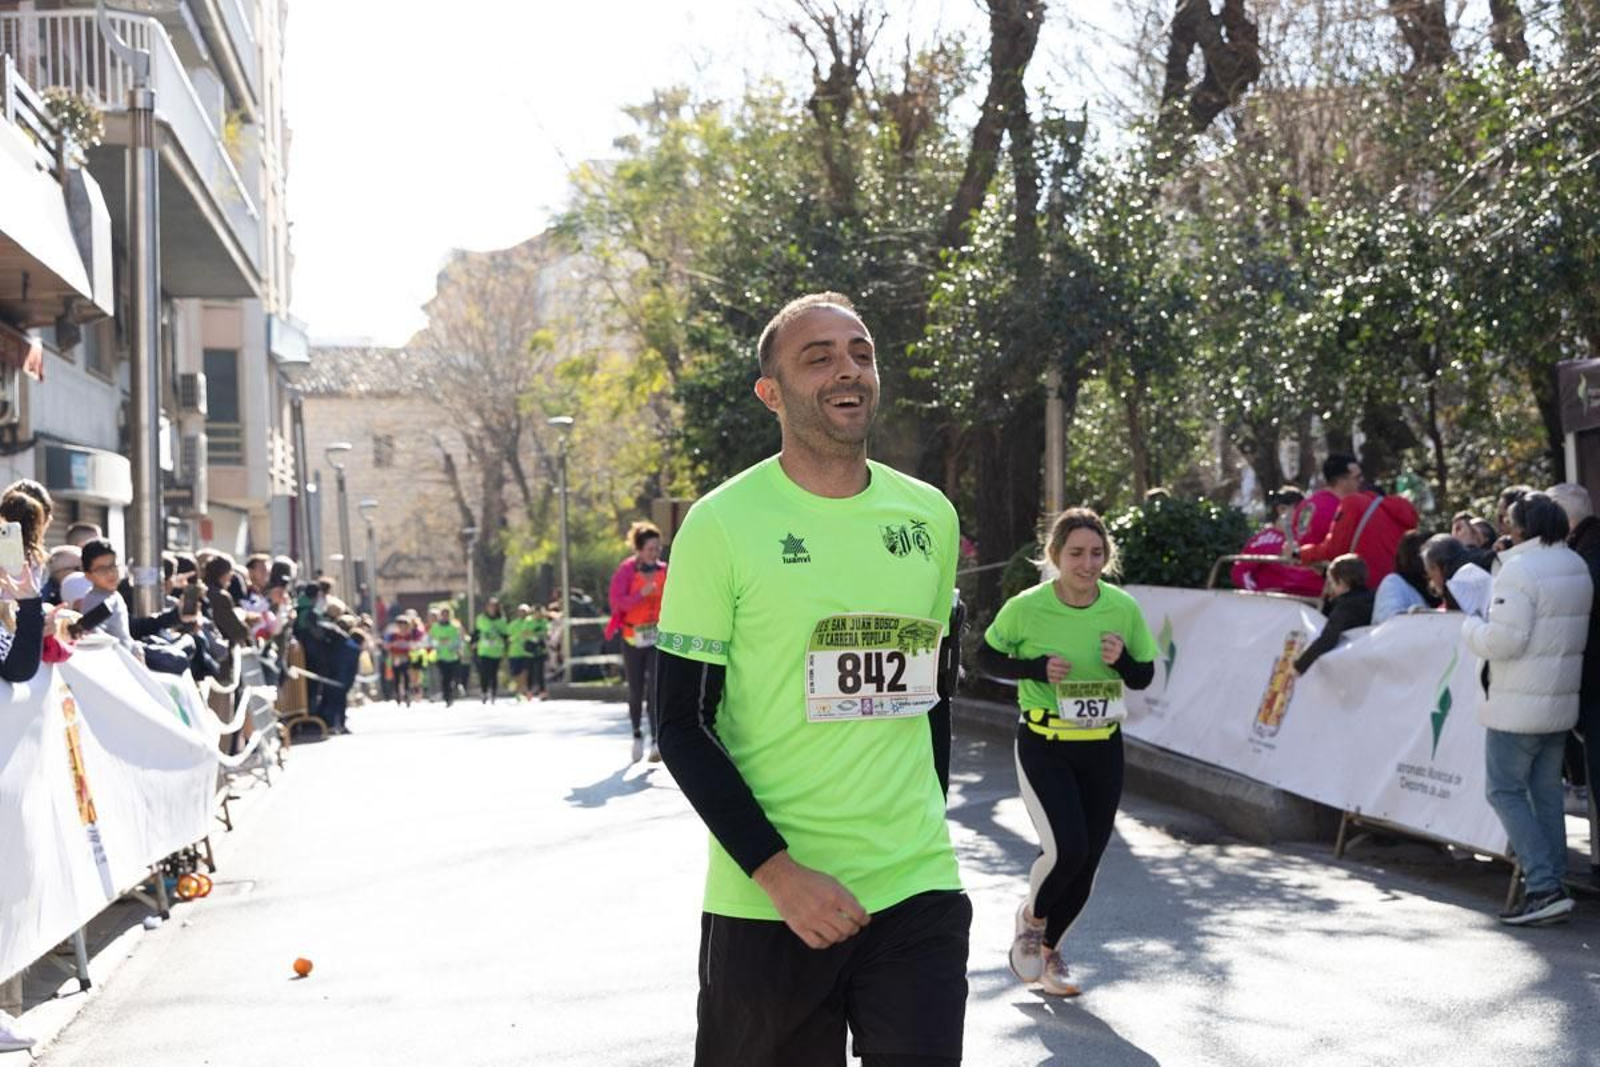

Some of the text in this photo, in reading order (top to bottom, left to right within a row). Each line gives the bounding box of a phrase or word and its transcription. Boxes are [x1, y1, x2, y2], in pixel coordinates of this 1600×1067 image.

[782, 555, 811, 564] luanvi
[831, 618, 847, 631] SAN
[849, 617, 872, 630] JUAN
[874, 617, 899, 630] BOSCO
[825, 632, 859, 646] CARRERA
[861, 631, 892, 646] POPULAR
[837, 651, 907, 695] 842
[1074, 699, 1109, 717] 267
